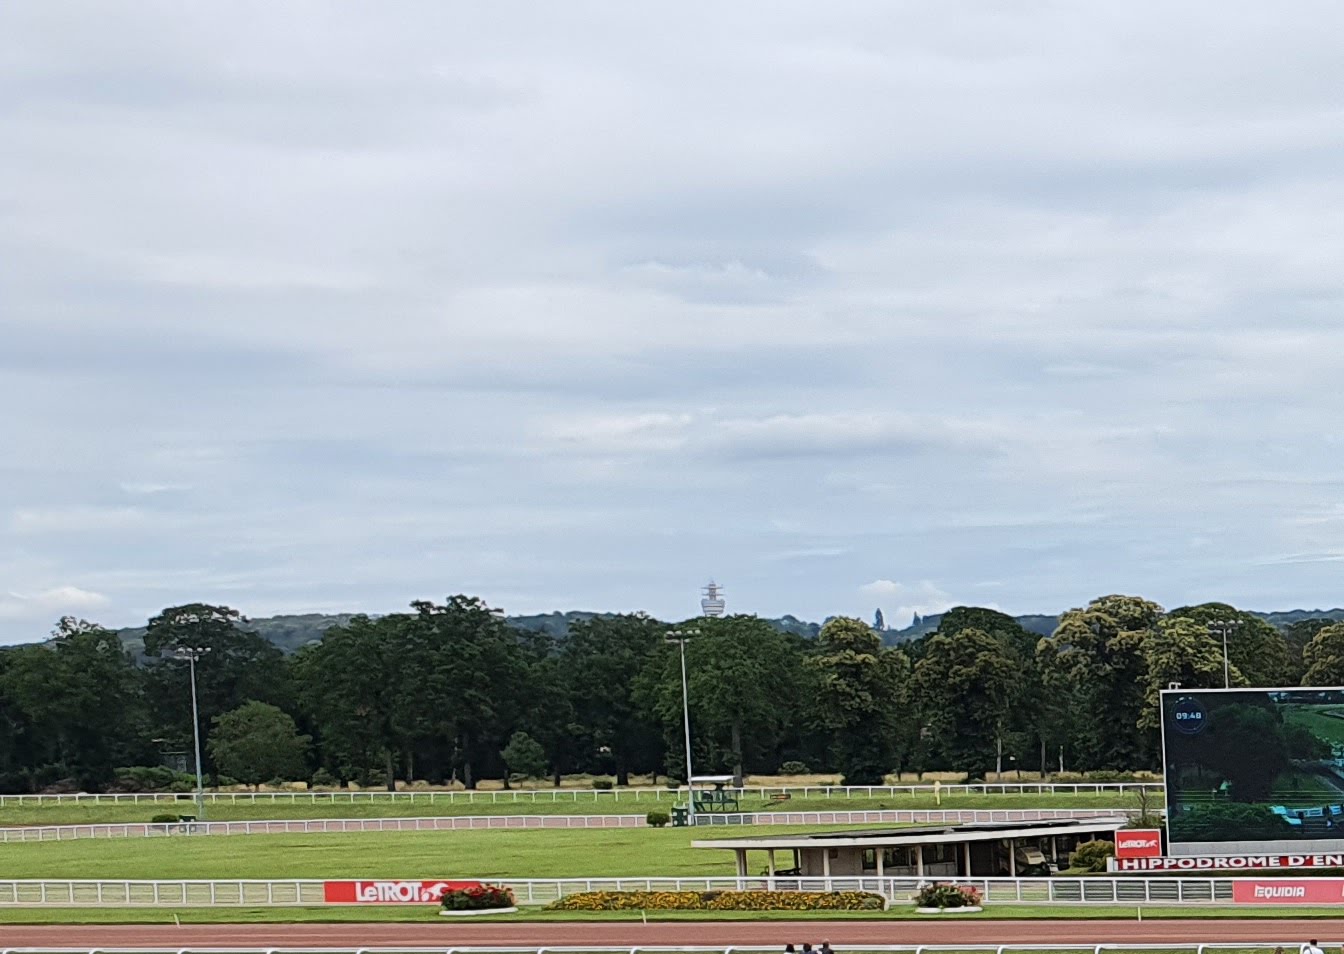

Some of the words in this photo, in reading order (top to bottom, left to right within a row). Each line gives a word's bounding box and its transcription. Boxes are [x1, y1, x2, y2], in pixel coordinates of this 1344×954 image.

[1122, 855, 1281, 870] HIPPODROME
[355, 881, 422, 902] LeTROT
[1254, 884, 1305, 899] EQUIDIA
